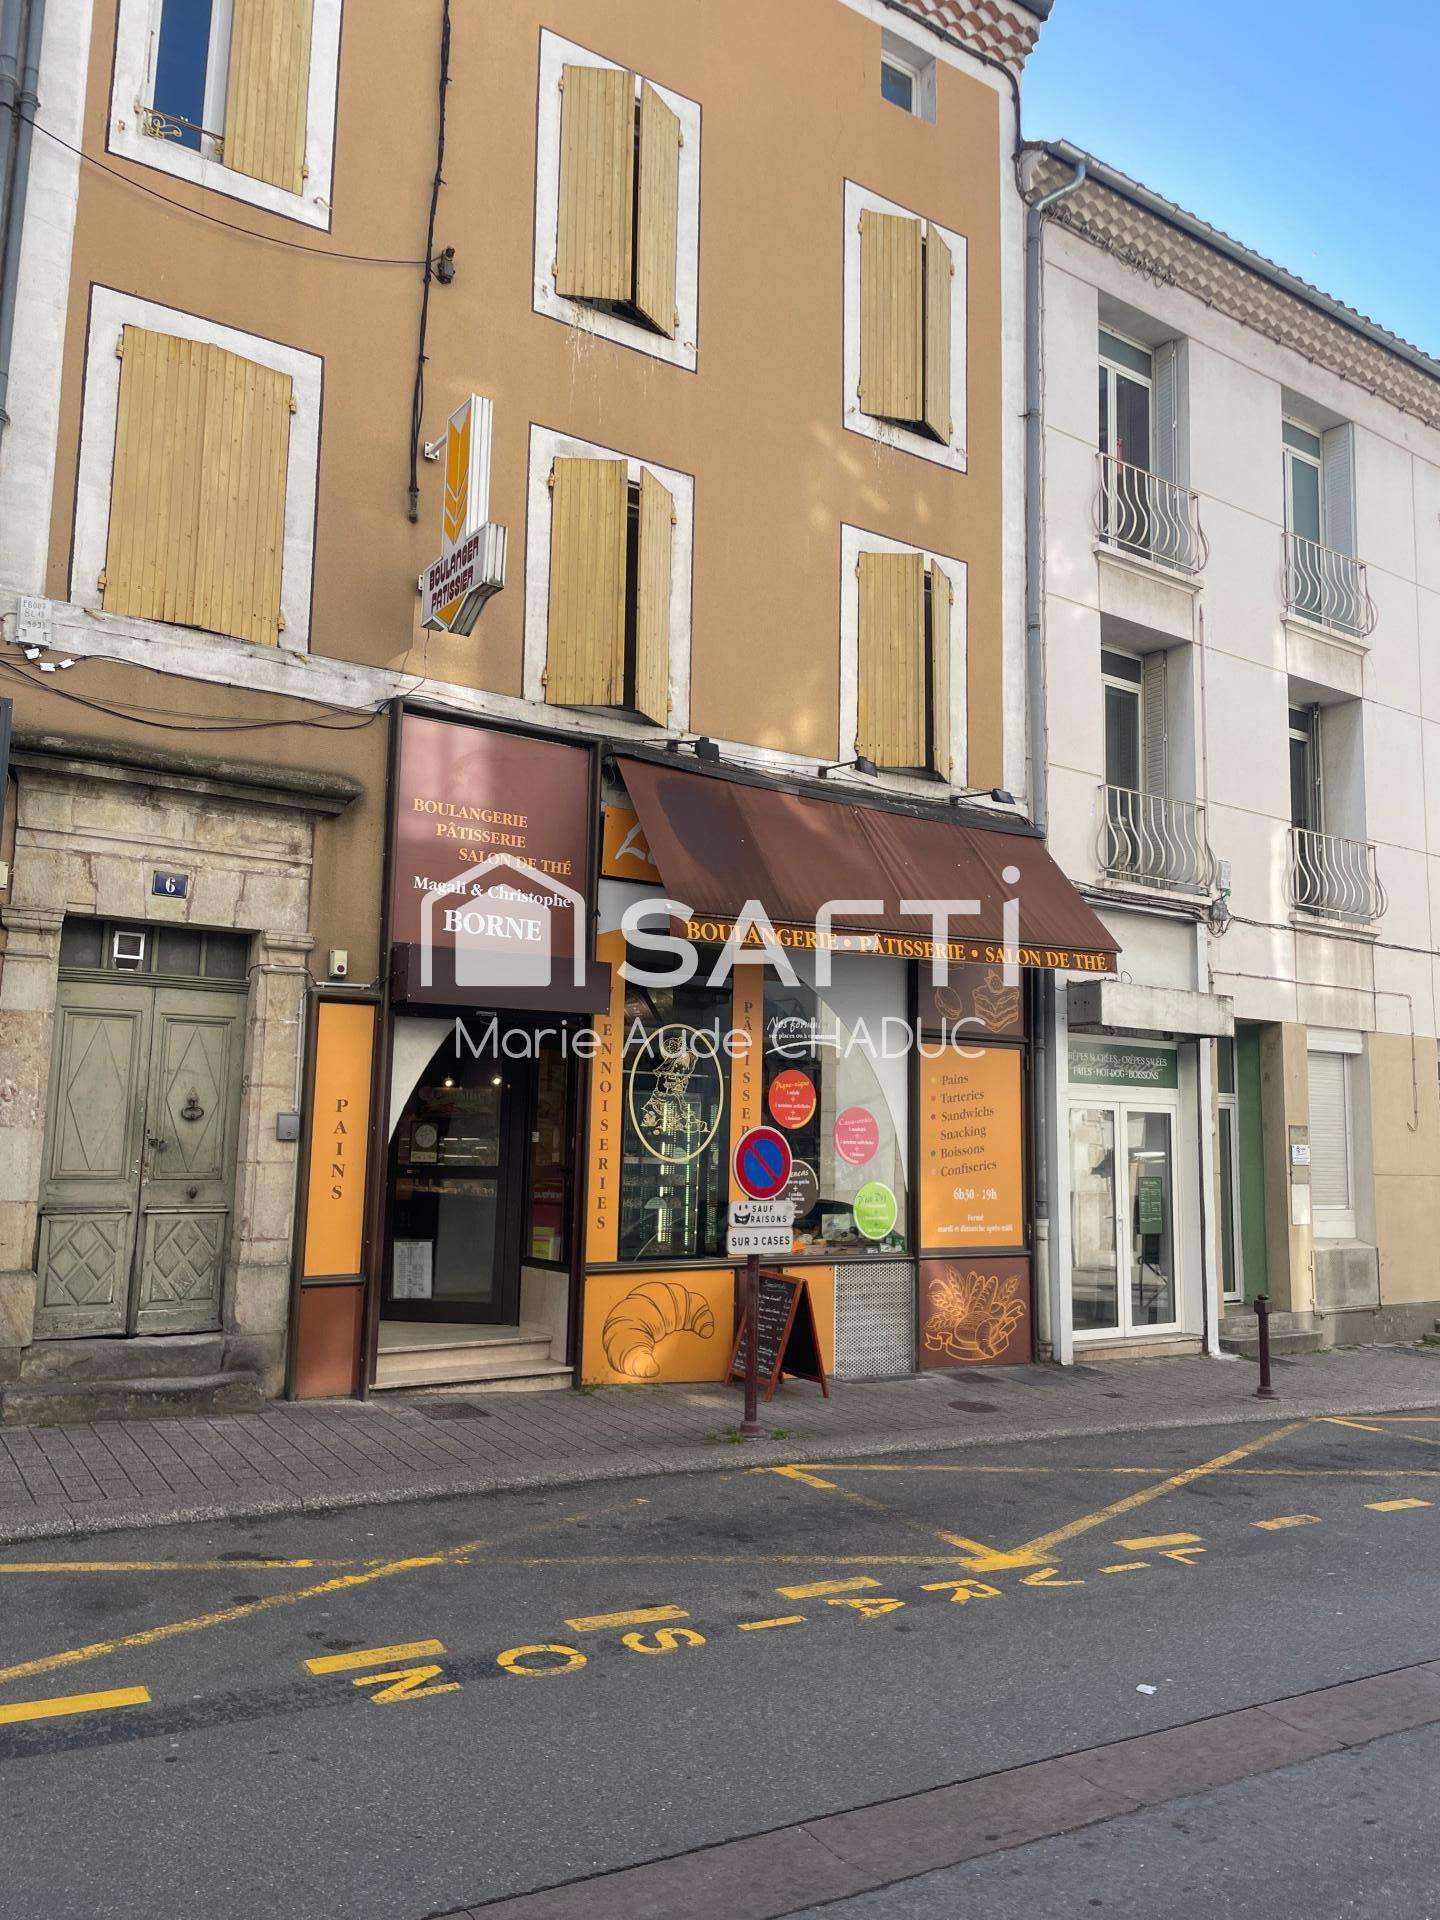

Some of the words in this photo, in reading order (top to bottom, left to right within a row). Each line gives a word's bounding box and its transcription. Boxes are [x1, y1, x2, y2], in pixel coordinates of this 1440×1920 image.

[429, 535, 480, 592] BOULANGER
[413, 798, 528, 829] BOULANGERIE
[436, 821, 526, 848] PÂTISSERIE
[458, 848, 512, 866] SALON
[516, 855, 537, 870] DE
[540, 855, 572, 876] THÉ
[165, 876, 176, 894] 6
[413, 875, 467, 896] Magali
[488, 884, 572, 910] Christophe
[443, 909, 542, 942] BORNE
[686, 920, 839, 950] BOULANGERIE
[858, 932, 966, 961] PÂTISSERIE
[985, 946, 1042, 967] SALON
[1047, 950, 1070, 968] DE
[1072, 951, 1107, 972] THÉ
[942, 1073, 969, 1086] Pains
[596, 1022, 613, 1230] ENNOISERIES
[941, 1106, 995, 1123] Sandwichs
[940, 1125, 986, 1141] Snacking
[330, 1098, 349, 1200] PAINS
[940, 1144, 985, 1160] Boissons
[940, 1159, 998, 1177] Confiseries
[752, 1205, 774, 1213] SAUF
[731, 1236, 750, 1247] SUR
[753, 1236, 759, 1246] 3
[761, 1235, 791, 1246] CASES
